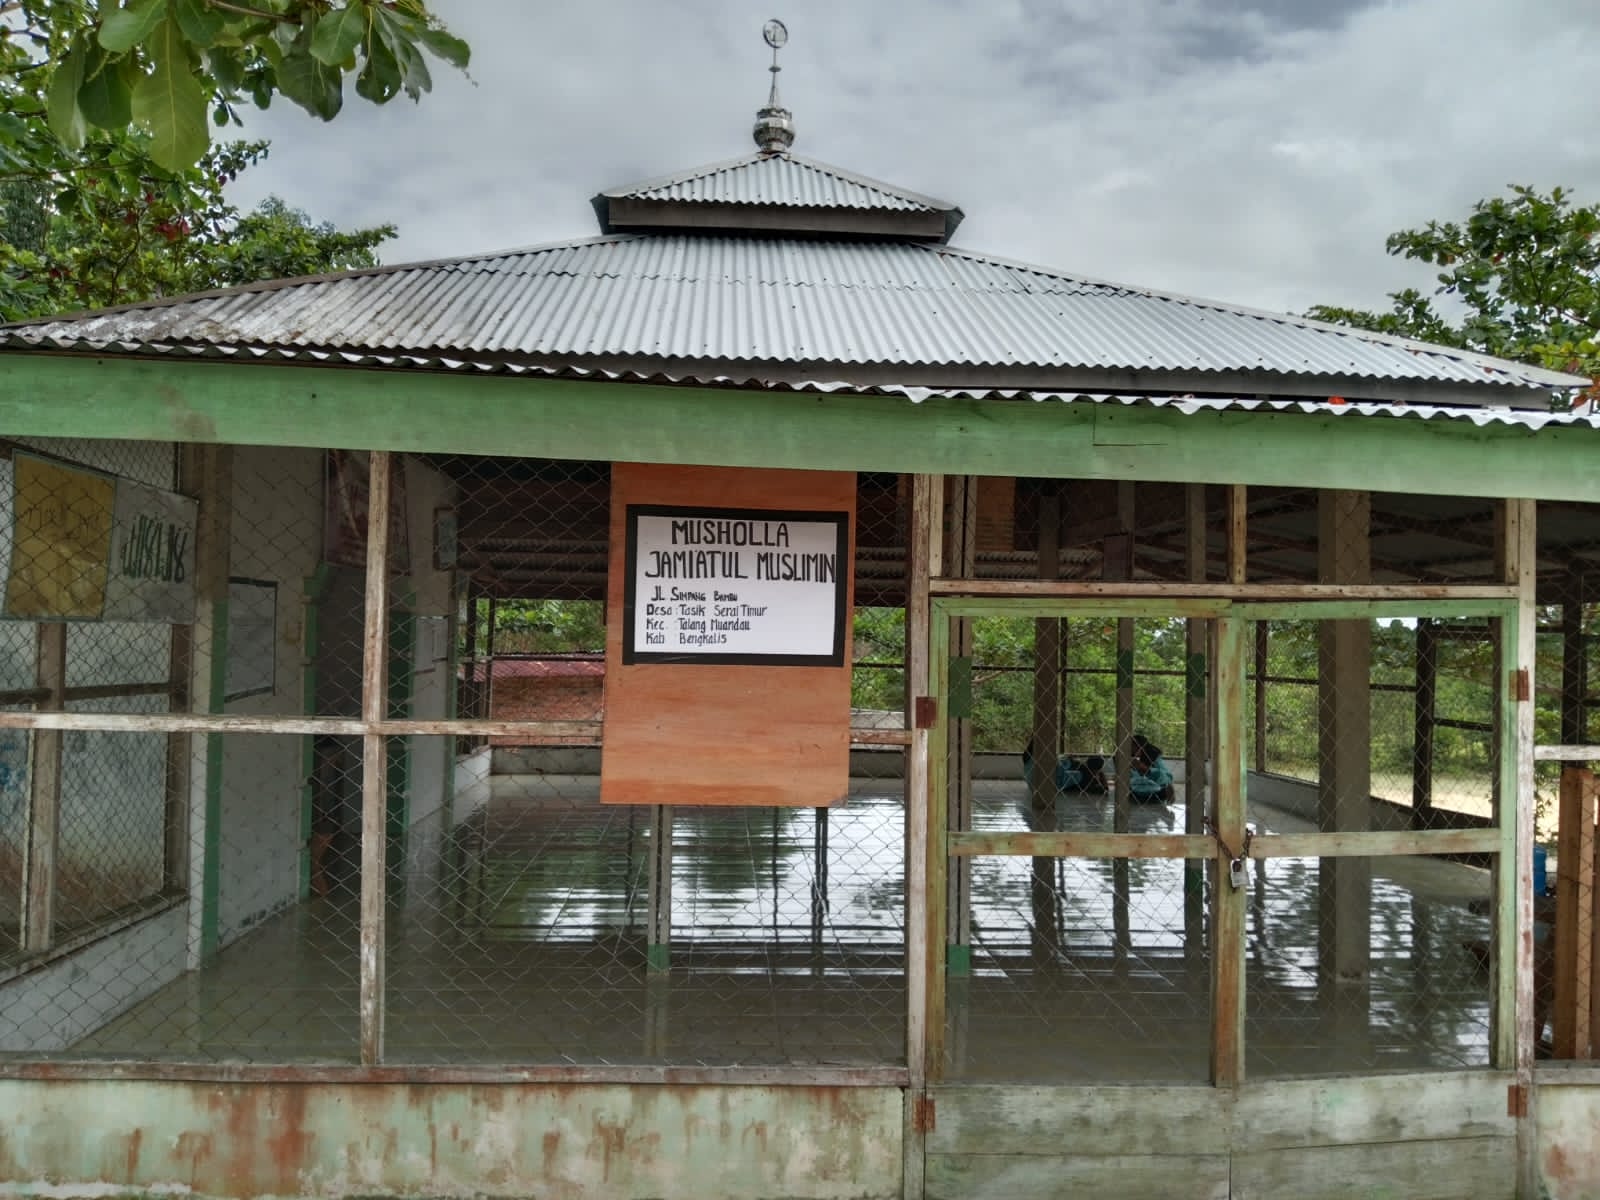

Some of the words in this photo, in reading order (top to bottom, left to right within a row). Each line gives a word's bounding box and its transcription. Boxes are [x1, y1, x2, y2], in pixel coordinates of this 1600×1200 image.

[672, 520, 789, 547] MUSHOLLA
[757, 552, 836, 583] MUSLIMIN
[679, 604, 706, 616] Tasik
[714, 605, 739, 617] Serai
[740, 604, 768, 617] Timur
[678, 617, 706, 633] Talang
